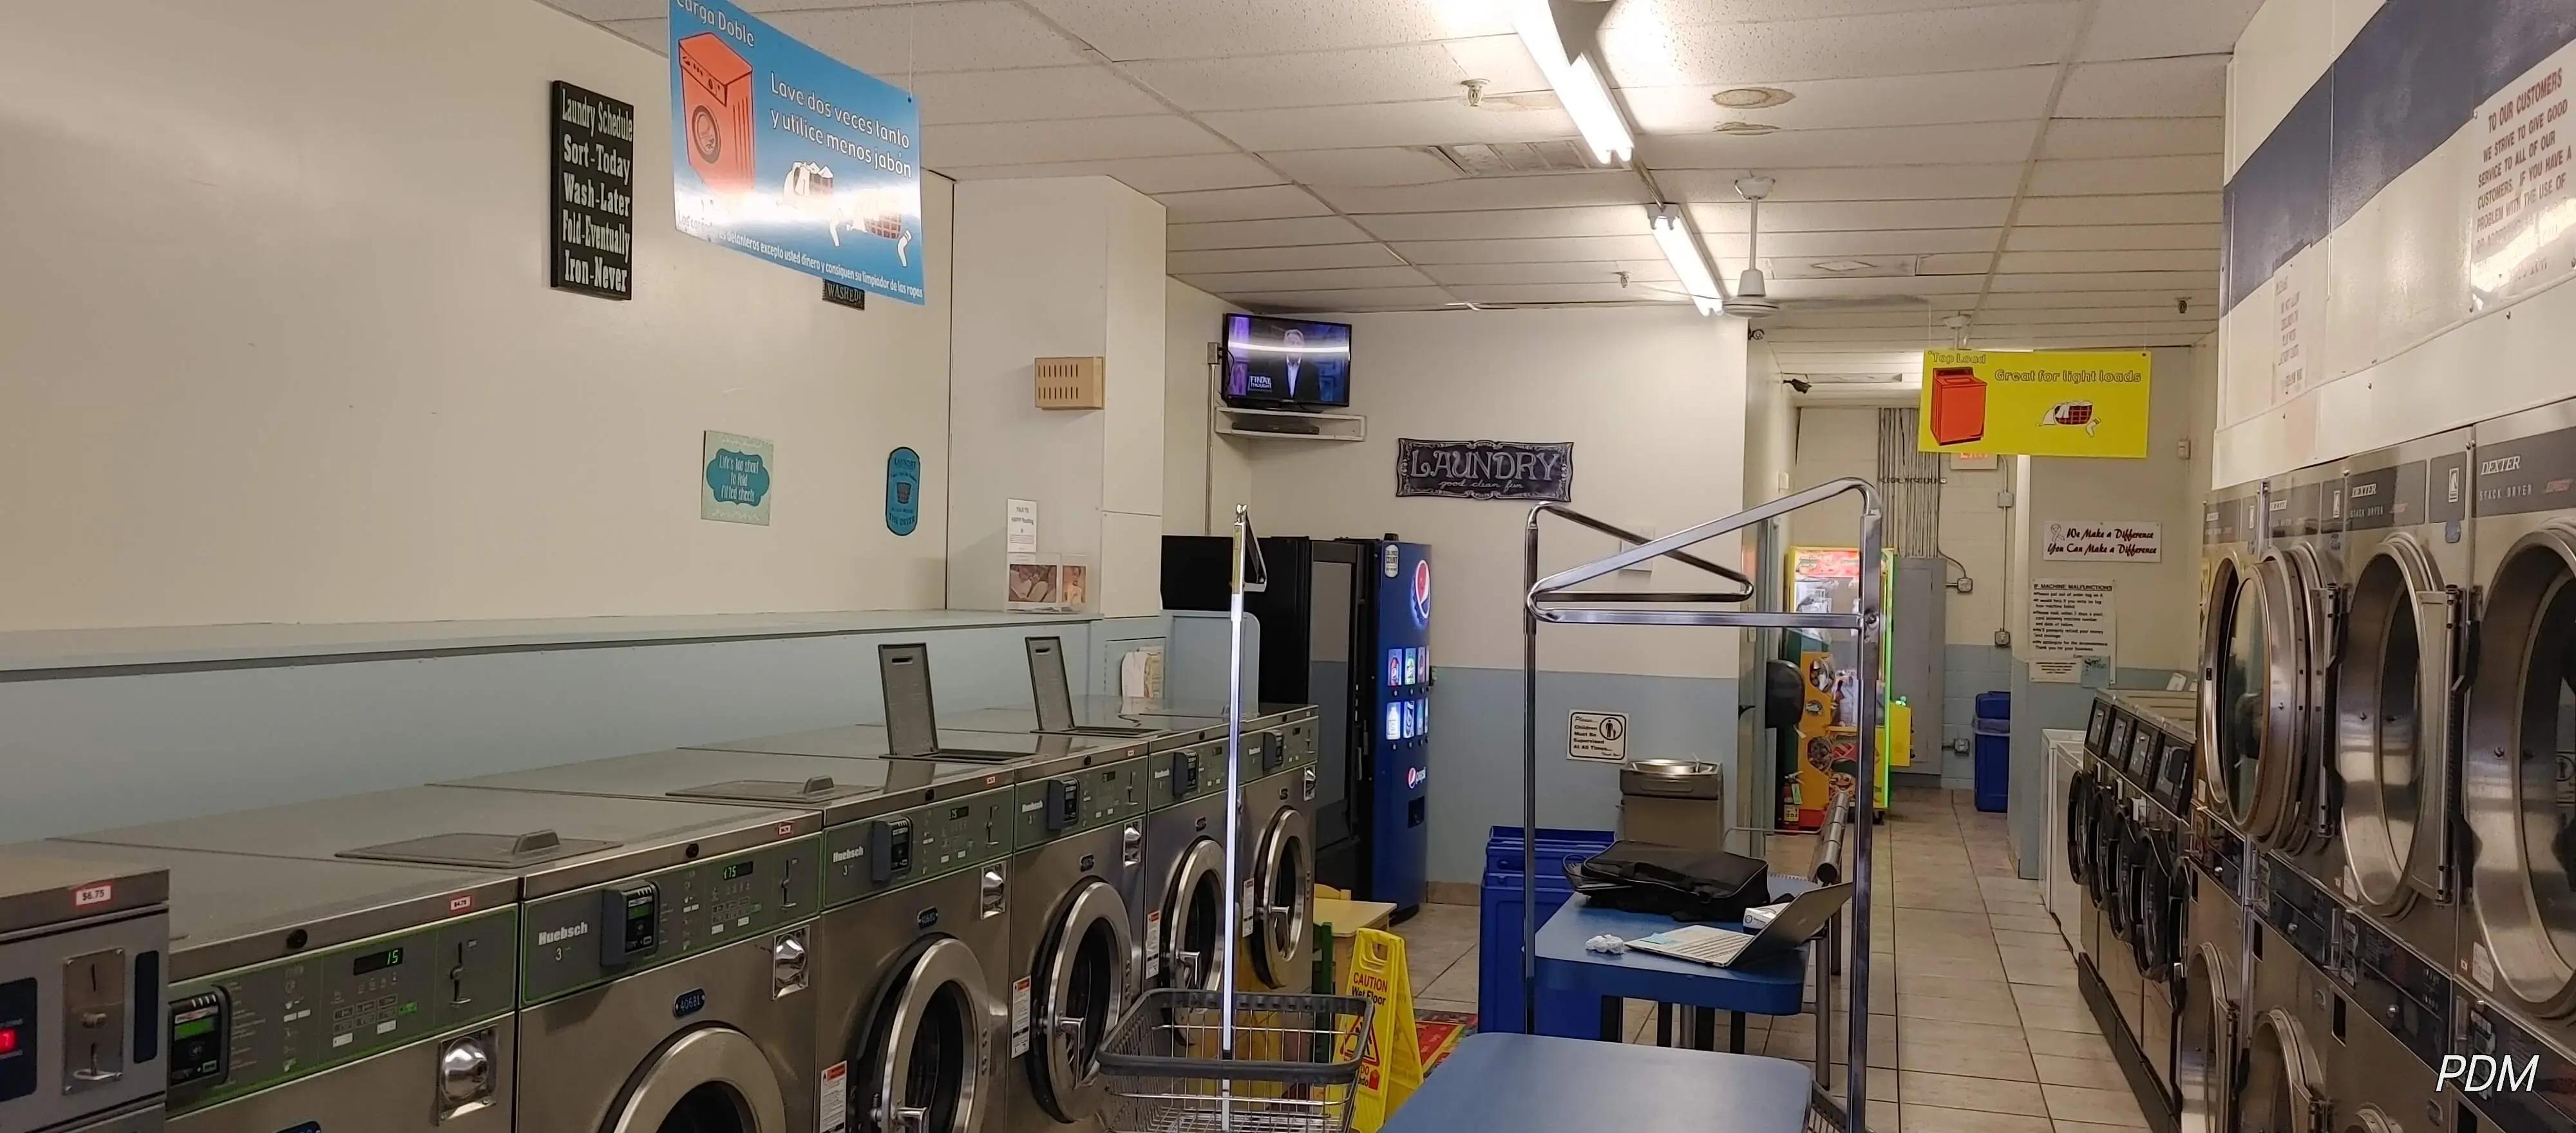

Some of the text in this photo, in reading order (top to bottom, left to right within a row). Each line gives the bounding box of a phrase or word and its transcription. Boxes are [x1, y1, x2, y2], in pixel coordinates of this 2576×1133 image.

[718, 10, 755, 47] Doble
[770, 71, 909, 149] Lave dos veces tanto
[2488, 67, 2562, 133] TO OUR CUSTOMERS
[562, 88, 632, 142] Laundry Schedule
[2483, 98, 2568, 163] WE STRIVE TO GIVE GOOD
[770, 108, 911, 178] y utilice menos jabón
[2478, 130, 2555, 188] SERVICE TO ALL OF OUR
[2519, 171, 2526, 187] IF
[2529, 160, 2543, 181] YOU
[2546, 149, 2563, 173] HAVE
[2566, 145, 2571, 161] A
[2539, 179, 2553, 200] USE
[2556, 172, 2566, 191] OF
[727, 231, 759, 251] delanteros
[760, 241, 784, 259] excepto
[784, 250, 800, 264] usted
[801, 253, 820, 270] dinero
[820, 263, 825, 273] y
[826, 262, 855, 279] consiguen
[855, 272, 862, 281] su
[862, 271, 890, 290] limpiador
[890, 279, 897, 292] de
[897, 281, 907, 294] las
[907, 287, 923, 299] ropas
[827, 283, 862, 303] WASHED!
[1932, 353, 1986, 364] Top Load
[1994, 369, 2141, 384] Great for light loads
[719, 454, 759, 474] Life's too short
[1410, 449, 1561, 480] LAUNDRY
[2481, 456, 2521, 475] DEXTER
[730, 472, 748, 487] to fold
[1439, 479, 1466, 489] good
[1503, 480, 1524, 494] fun
[721, 484, 755, 502] fitted sheets
[2351, 483, 2377, 498] DEXTER
[2479, 489, 2503, 501] STACK
[2507, 484, 2532, 498] DRYER
[2067, 529, 2080, 538] We
[2081, 528, 2105, 540] Make
[2114, 529, 2154, 541] Difference
[2047, 543, 2064, 555] You
[2067, 543, 2083, 553] Can
[2084, 543, 2107, 556] Make
[2117, 544, 2157, 557] Difference
[82, 890, 104, 901] $6.75
[538, 921, 588, 946] Huebsch
[387, 950, 399, 965] 15
[556, 947, 562, 960] 3
[1353, 972, 1388, 993] CAUTION
[1352, 986, 1386, 1006] Wet Floor
